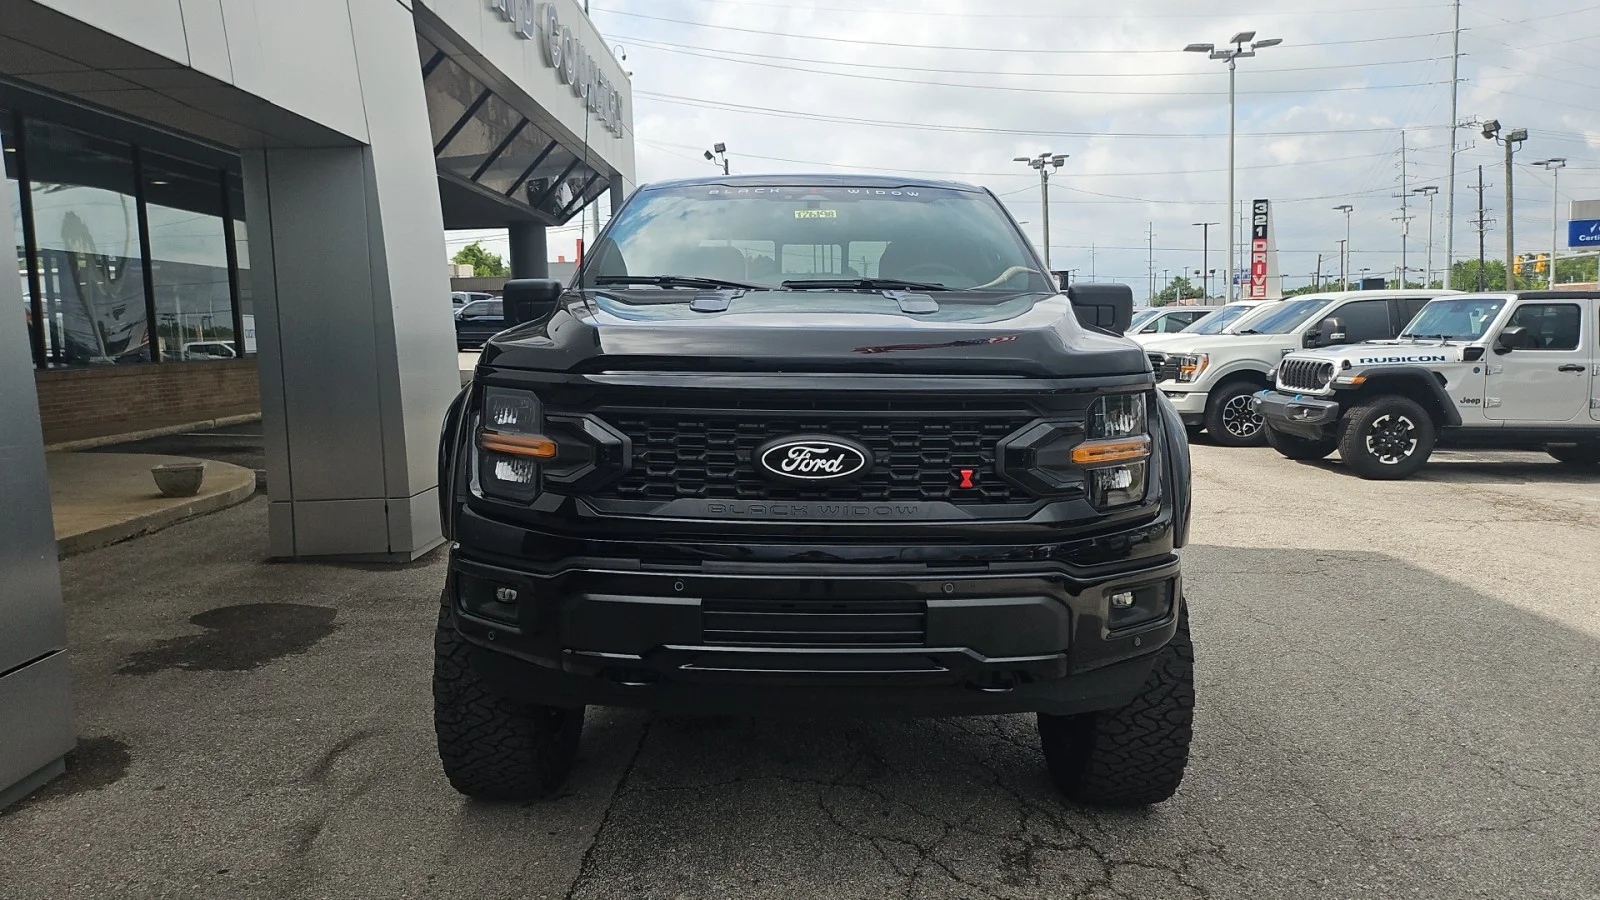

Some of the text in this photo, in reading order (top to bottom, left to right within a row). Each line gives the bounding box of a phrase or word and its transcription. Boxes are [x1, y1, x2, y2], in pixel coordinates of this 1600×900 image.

[708, 187, 919, 197] BLACK WIDOW
[1252, 202, 1268, 296] 321 DRIVE
[1360, 355, 1446, 364] RUBICON
[1460, 396, 1481, 405] Jeep
[781, 446, 845, 473] Ford
[707, 503, 919, 516] BLACK WIDOW
